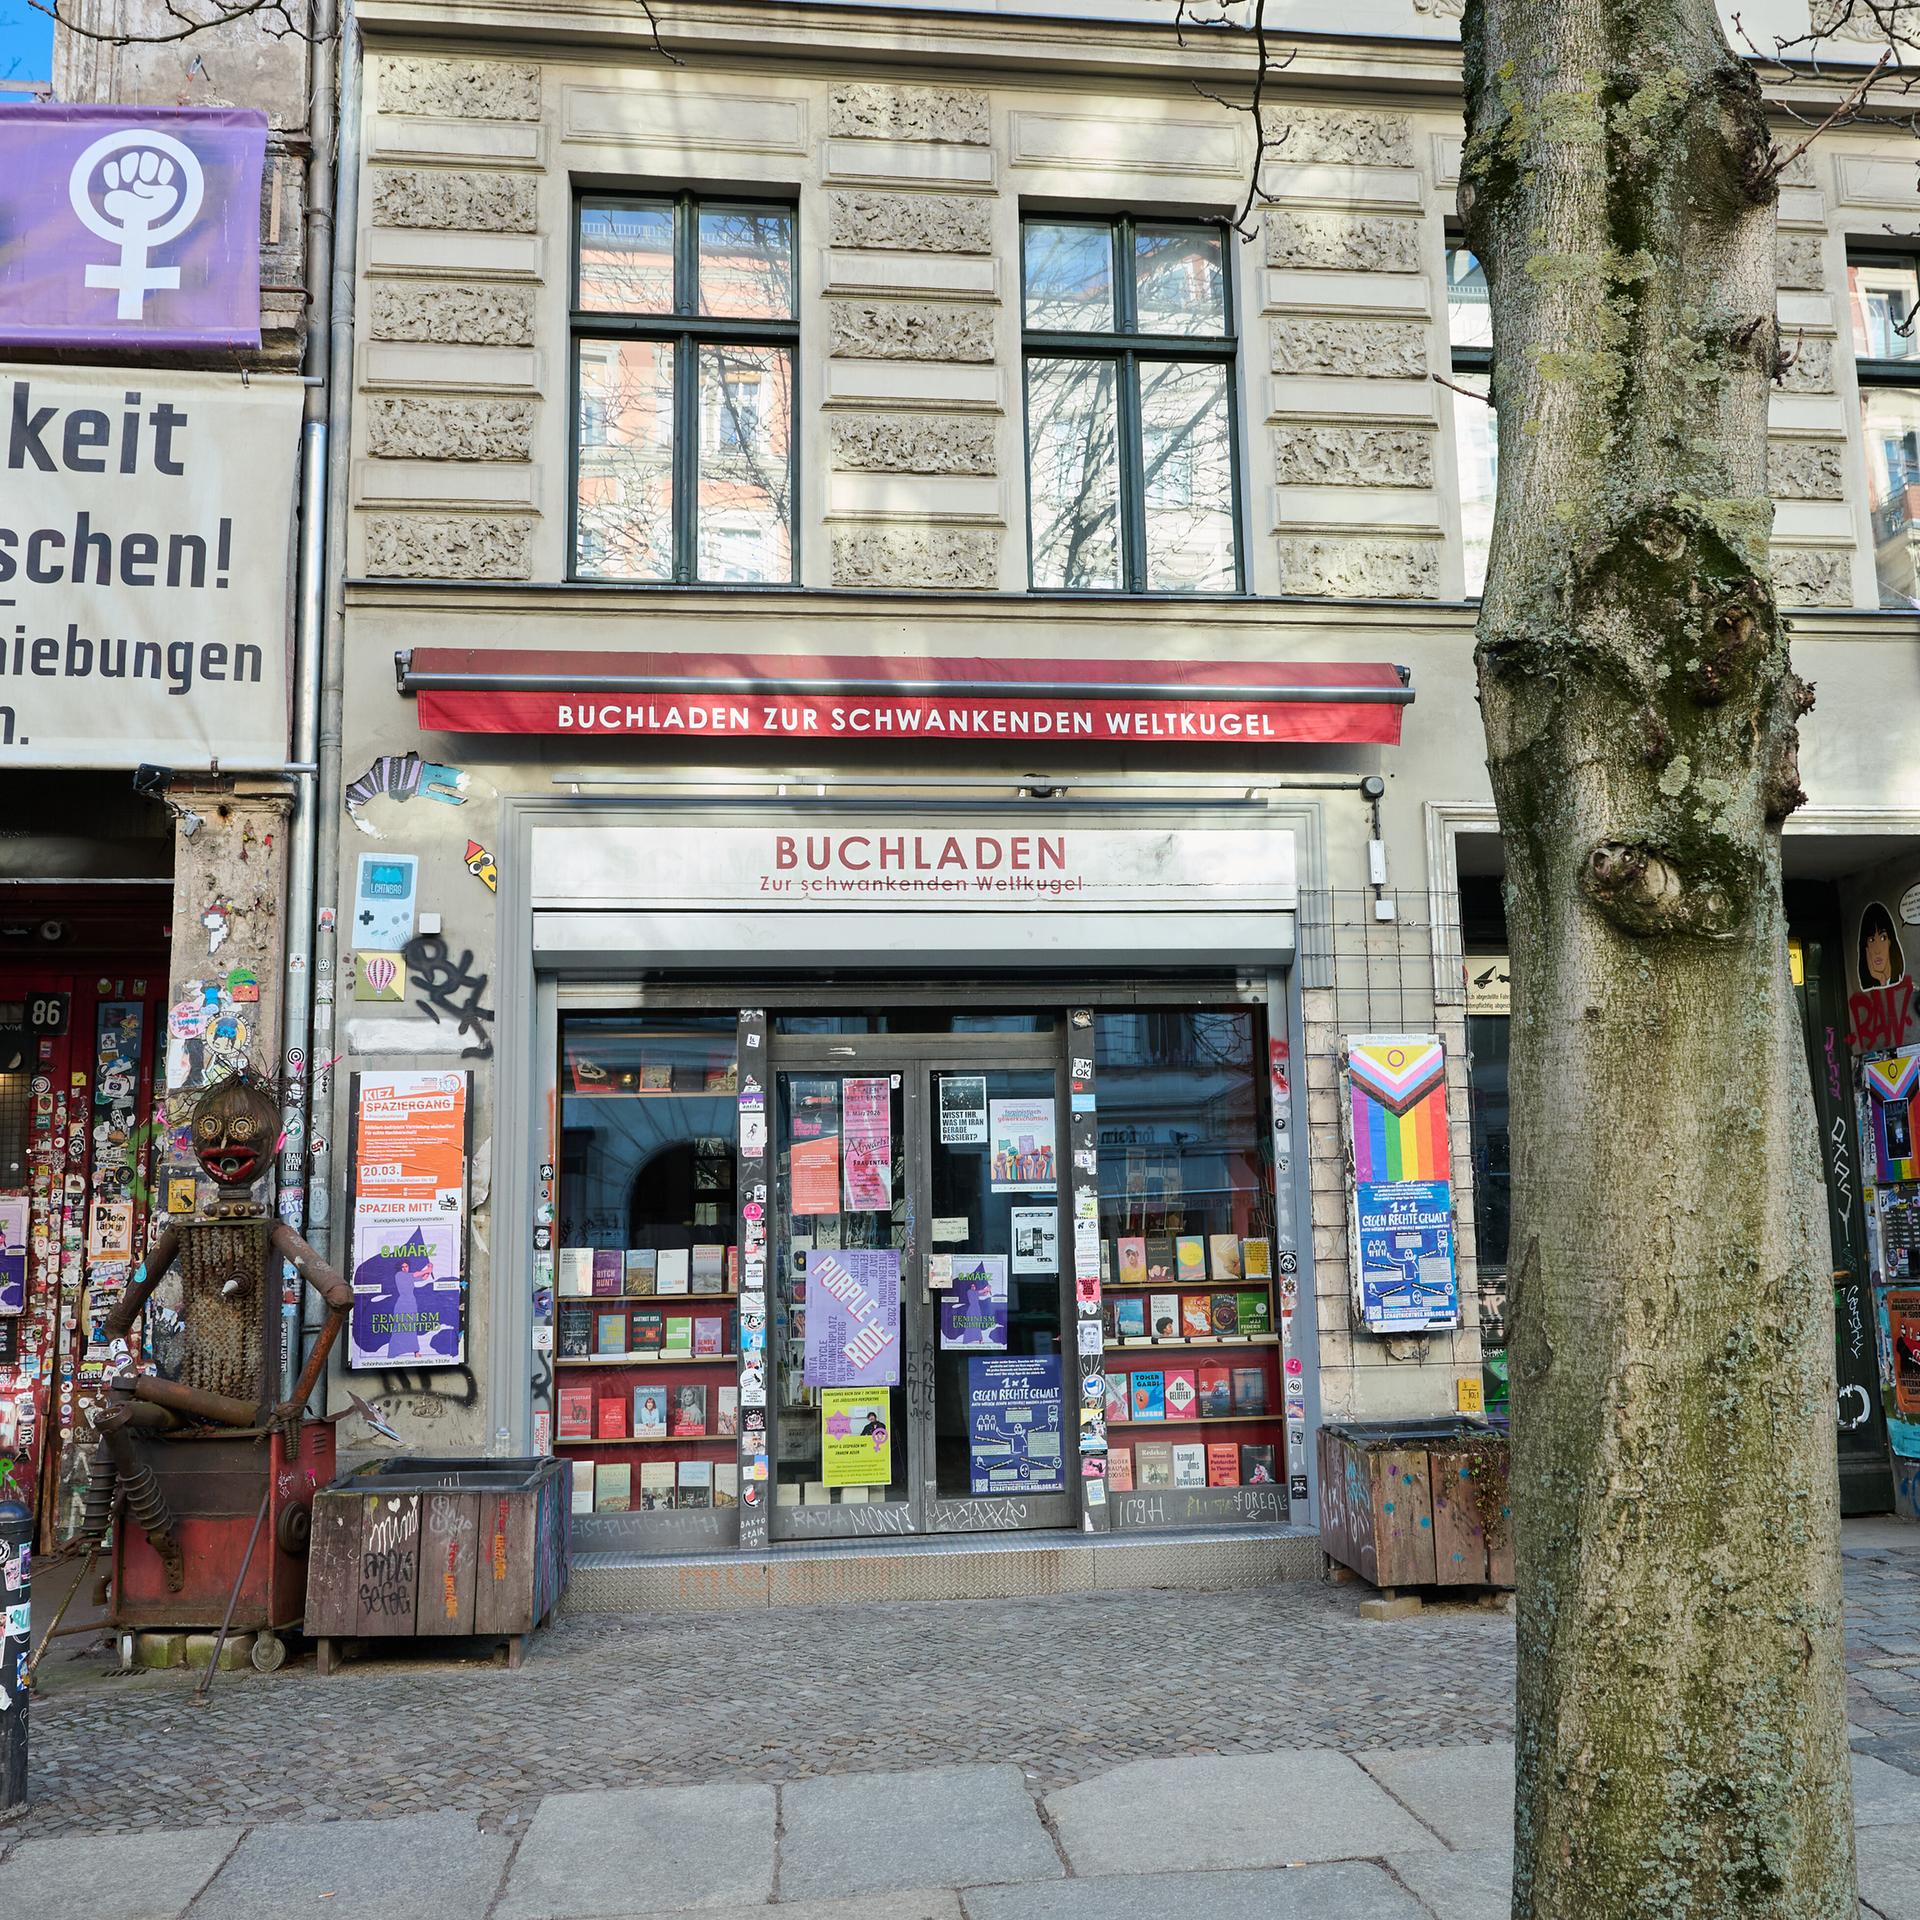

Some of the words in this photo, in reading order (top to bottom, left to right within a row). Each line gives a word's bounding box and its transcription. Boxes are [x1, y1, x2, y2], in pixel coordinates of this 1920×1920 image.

[8, 382, 187, 475] keit
[0, 624, 262, 695] iebungen
[557, 705, 749, 729] BUCHLADEN
[763, 707, 819, 731] ZUR
[832, 708, 1092, 735] SCHWANKENDEN
[1105, 712, 1275, 736] WELTKUGEL
[776, 836, 1066, 870] BUCHLADEN
[760, 876, 792, 891] Zur
[800, 875, 967, 892] schwankenden
[976, 875, 1082, 894] Weltkugel
[32, 1000, 60, 1025] 86
[364, 1088, 393, 1101] KIEZ
[366, 1099, 451, 1113] SPAZIERGANG
[363, 1166, 399, 1177] 20.03.
[359, 1204, 405, 1213] SPAZIER
[408, 1203, 432, 1213] MIT!
[1362, 1215, 1387, 1226] GEGEN
[1389, 1213, 1418, 1226] RECHTE
[1419, 1212, 1448, 1224] GEWALT
[869, 1254, 878, 1267] DAY
[859, 1254, 868, 1287] FEMINIST
[869, 1270, 878, 1279] OF
[888, 1270, 896, 1279] OF
[596, 1279, 613, 1287] HUNT
[811, 1255, 880, 1323] PURPLE
[878, 1254, 887, 1309] INTERNATIONAL
[888, 1280, 896, 1305] MARCH
[372, 1312, 439, 1323] FEMINISM
[888, 1308, 896, 1326] 2026
[372, 1322, 441, 1333] UNLIMITED
[828, 1315, 837, 1382] MARIANNENPLATZ
[842, 1317, 894, 1371] RIDE
[819, 1340, 827, 1370] BICYCLE
[809, 1356, 818, 1384] LINTA
[973, 1390, 997, 1401] GEGEN
[1000, 1389, 1028, 1400] RECHTE
[1030, 1387, 1059, 1399] GEWALT
[1177, 1452, 1194, 1461] kampf
[1177, 1477, 1204, 1486] bewusste
